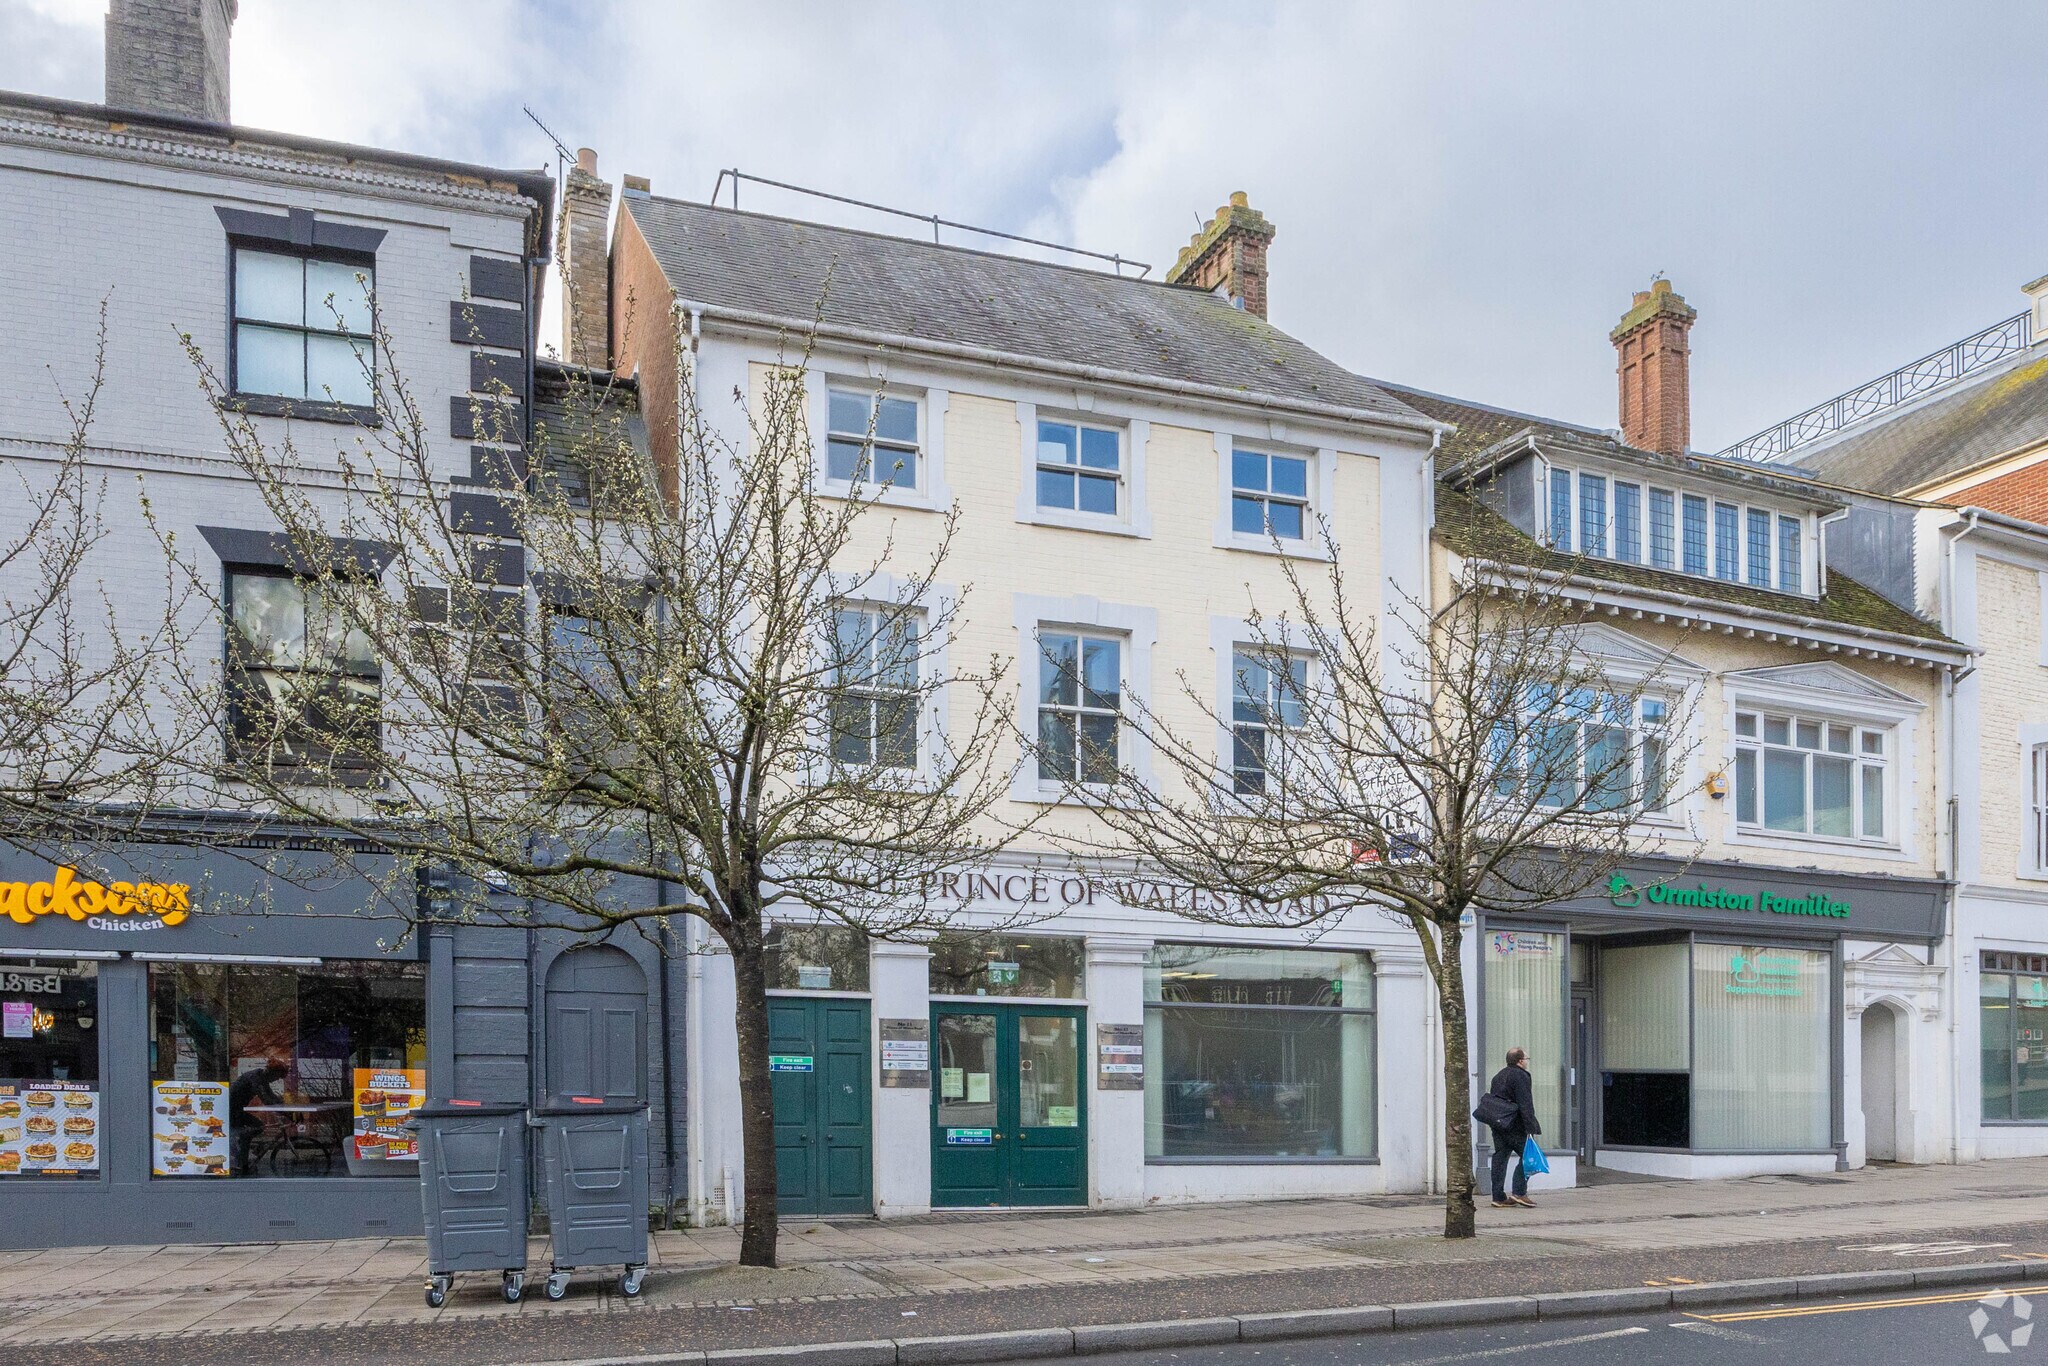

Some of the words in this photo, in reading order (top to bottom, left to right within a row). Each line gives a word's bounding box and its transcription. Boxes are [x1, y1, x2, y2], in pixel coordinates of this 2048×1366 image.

[919, 870, 1050, 903] PRINCE
[1060, 878, 1101, 905] OF
[1114, 881, 1228, 913] WALES
[1650, 883, 1753, 911] Ormiston
[1760, 891, 1851, 918] Families
[87, 917, 164, 931] Chicken
[1725, 985, 1773, 997] Supporting
[1775, 987, 1804, 996] Smiles
[29, 1083, 62, 1091] LOADED
